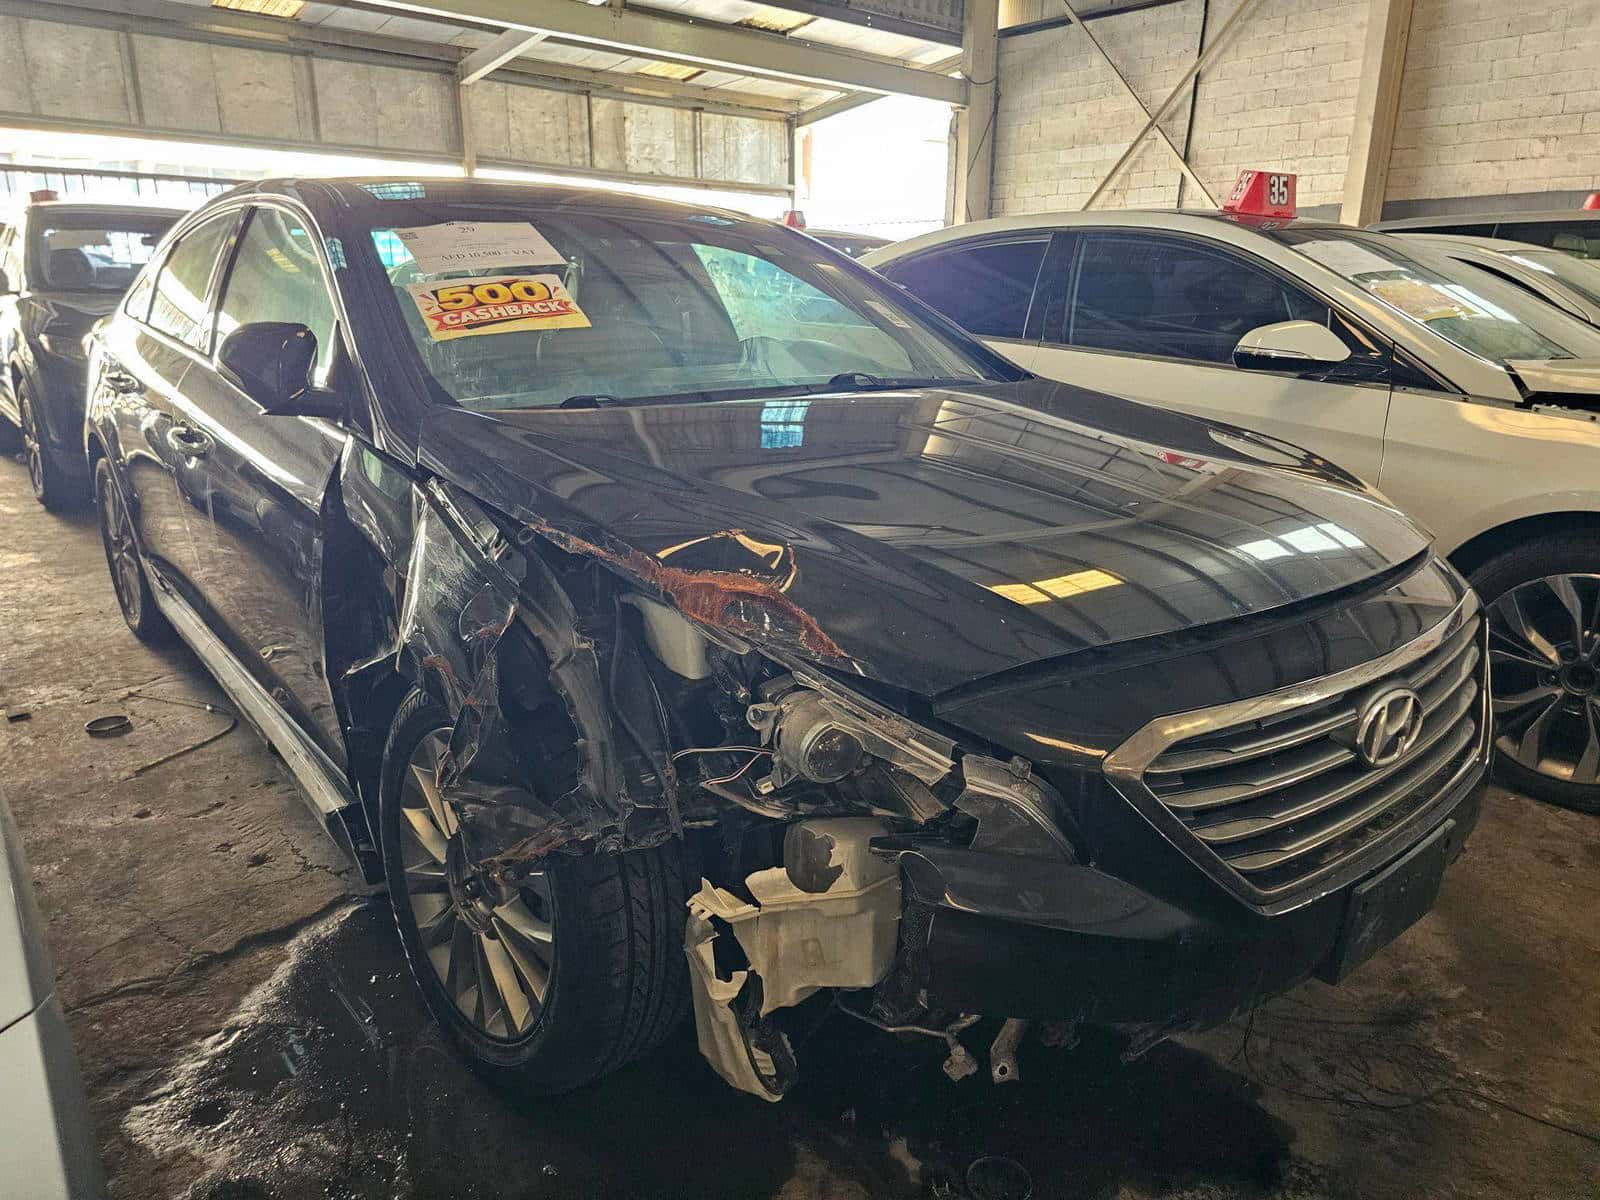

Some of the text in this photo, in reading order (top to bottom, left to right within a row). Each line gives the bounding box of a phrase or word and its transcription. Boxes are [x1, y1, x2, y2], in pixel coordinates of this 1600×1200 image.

[1269, 175, 1288, 205] 35
[435, 280, 551, 311] 500
[441, 298, 566, 326] CASHBACK
